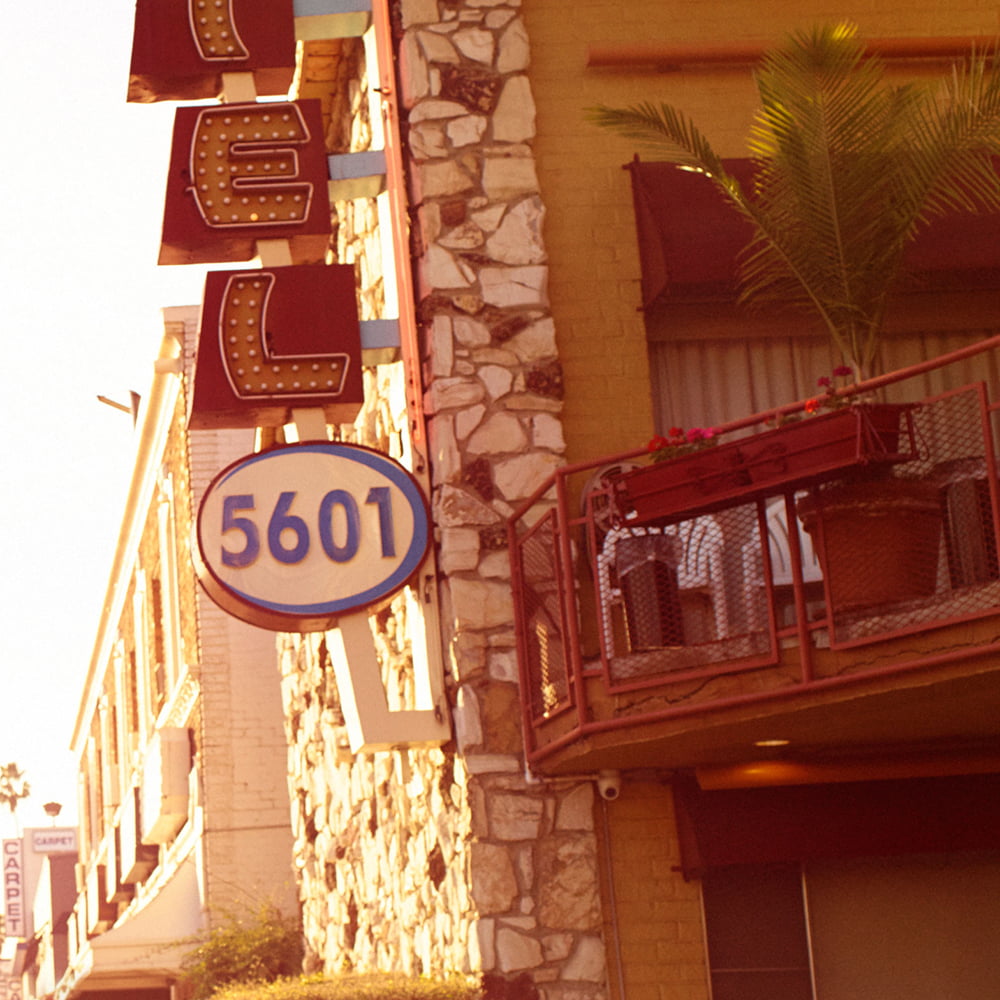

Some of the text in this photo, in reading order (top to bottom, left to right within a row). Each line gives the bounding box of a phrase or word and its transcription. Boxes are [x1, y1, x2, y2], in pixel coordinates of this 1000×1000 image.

[220, 486, 397, 569] 5601
[34, 837, 73, 845] CARPET
[4, 842, 20, 932] CARPET
